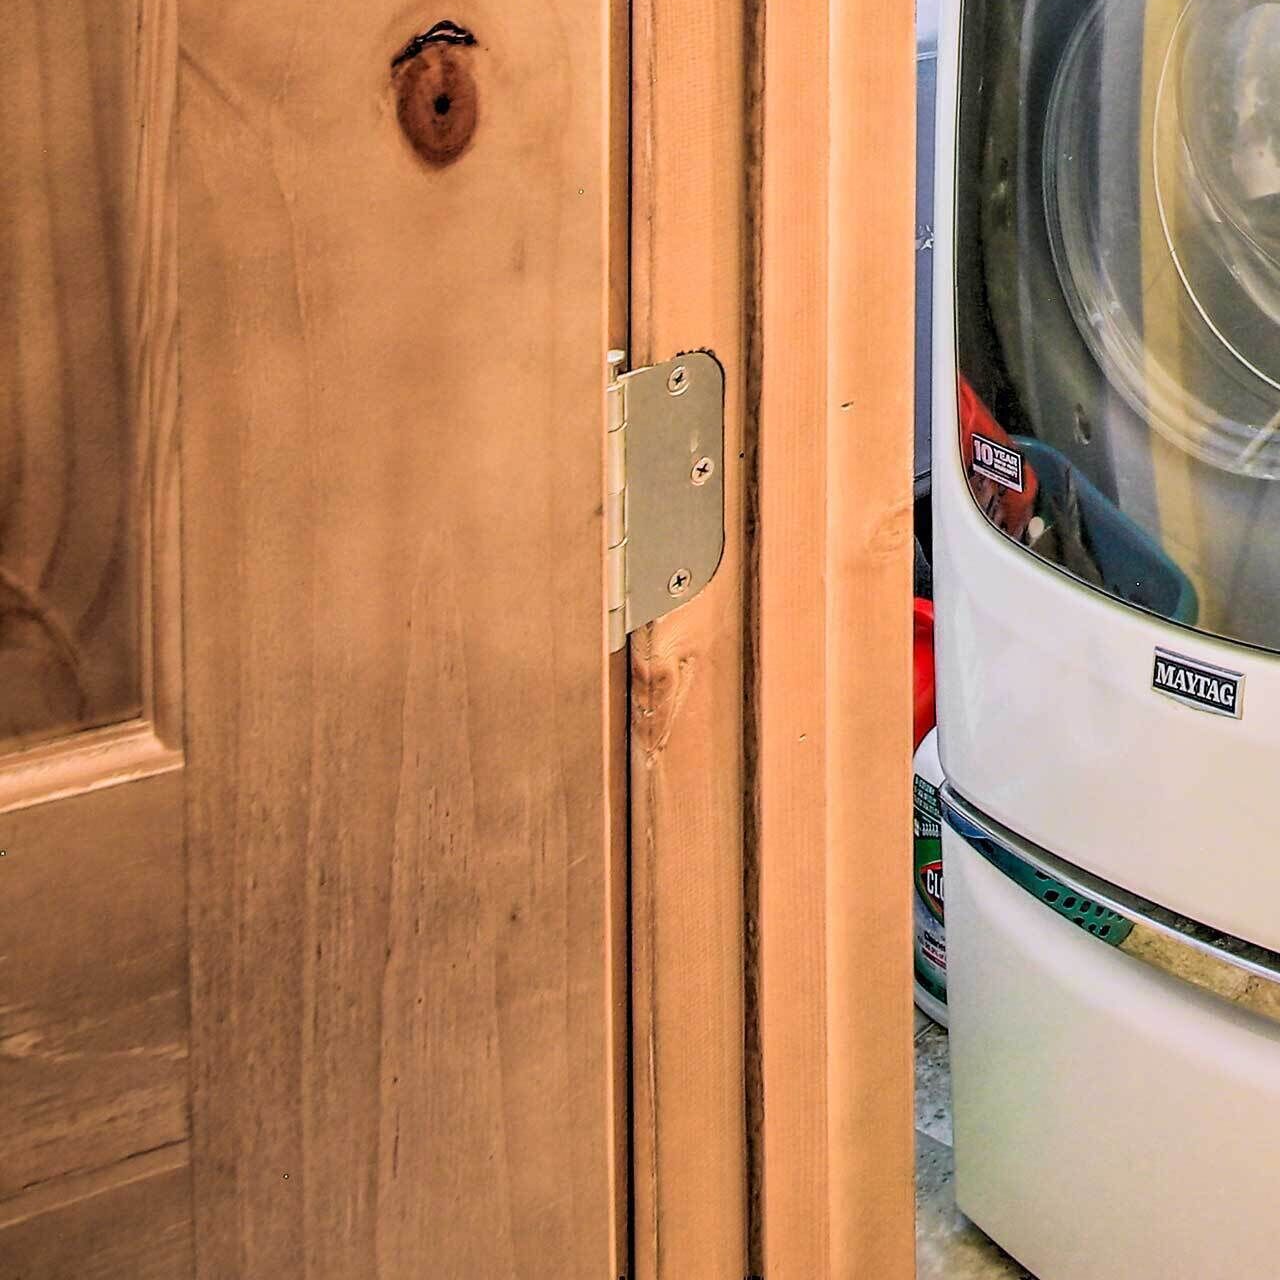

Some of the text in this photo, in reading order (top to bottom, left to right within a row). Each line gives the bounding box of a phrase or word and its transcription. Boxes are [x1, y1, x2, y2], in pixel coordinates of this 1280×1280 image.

[974, 440, 1018, 466] 10 YEAR
[1155, 661, 1235, 707] MAYTAG
